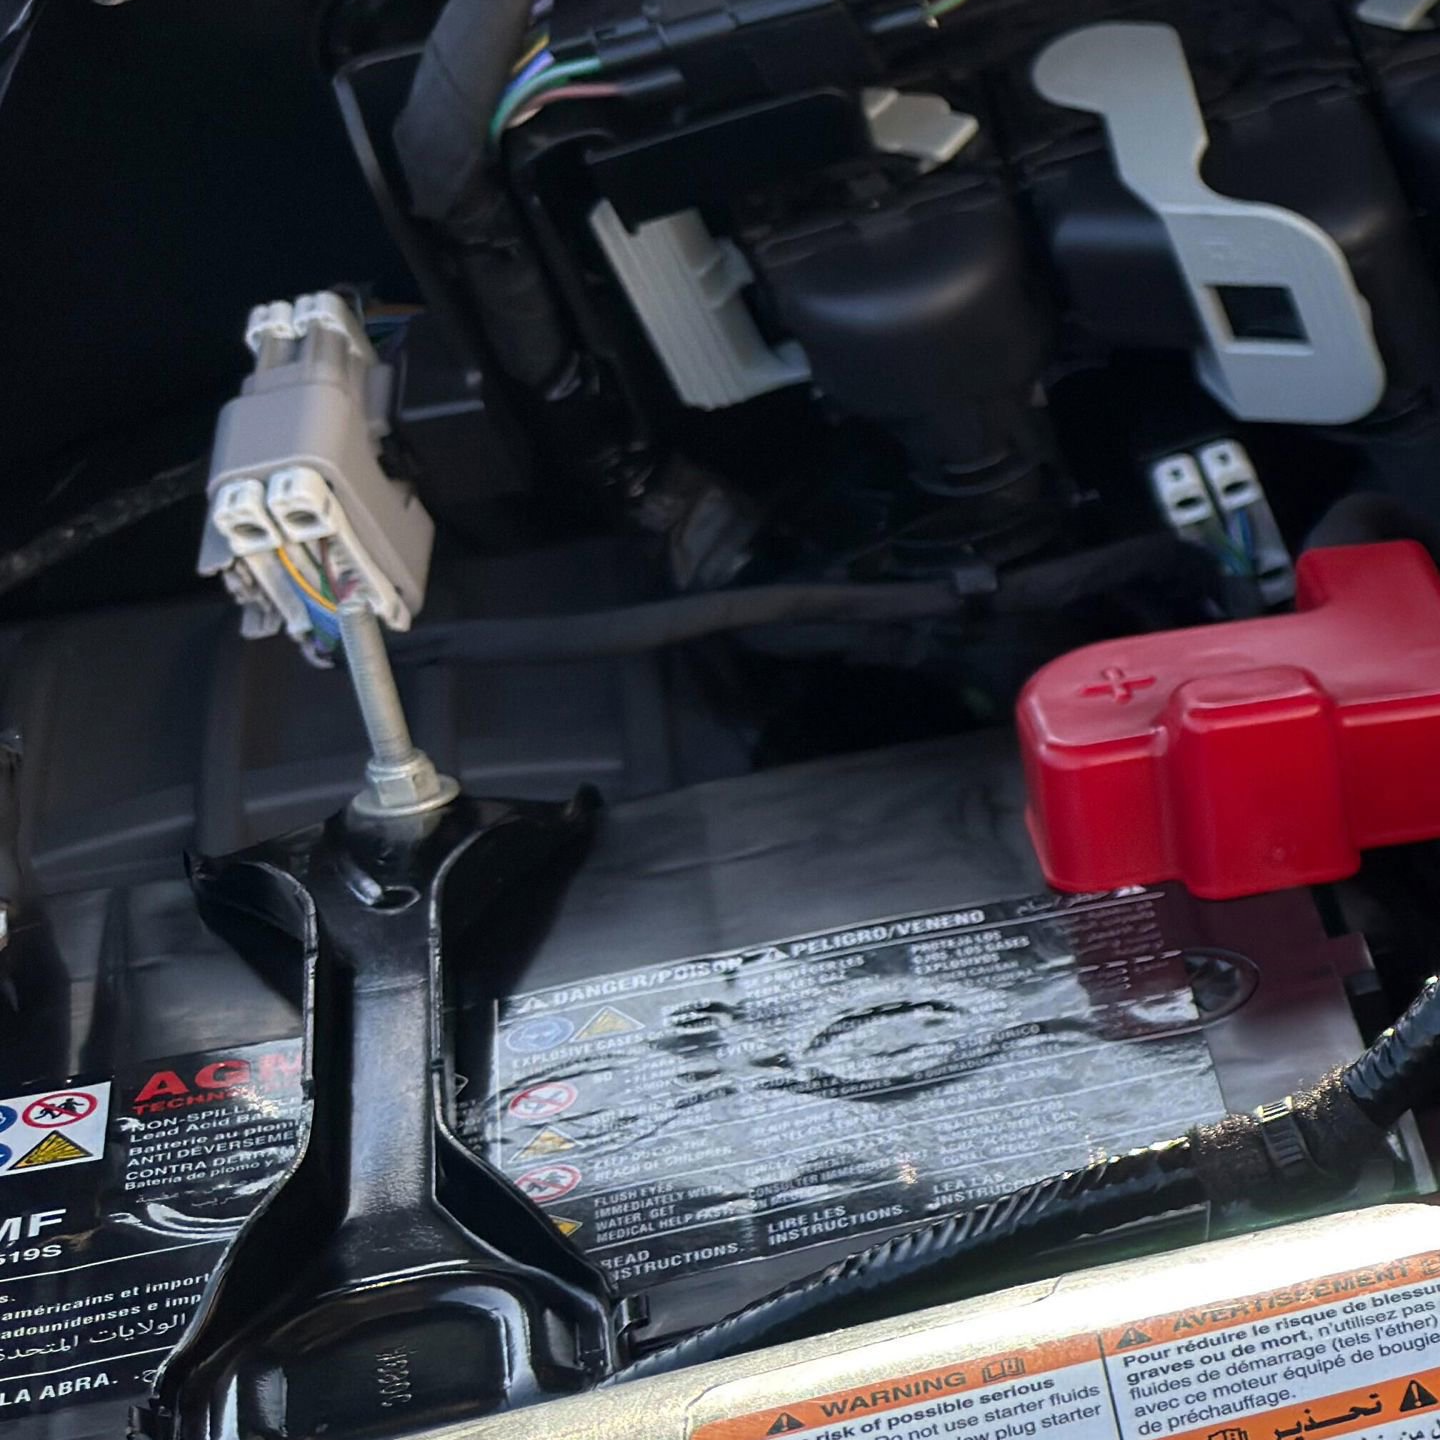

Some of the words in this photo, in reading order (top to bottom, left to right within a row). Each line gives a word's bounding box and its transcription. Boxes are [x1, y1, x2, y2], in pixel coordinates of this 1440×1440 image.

[792, 909, 986, 956] PELIGRO/VENENO
[128, 1135, 209, 1157] Batterie
[213, 1131, 239, 1142] au
[129, 1126, 180, 1144] Lead
[185, 1117, 231, 1134] Acid
[125, 1160, 208, 1182] CONTRA
[126, 1150, 172, 1169] ANTI
[186, 1170, 207, 1181] de
[210, 1162, 261, 1178] plomo
[594, 1219, 655, 1245] MEDICAL
[657, 1210, 693, 1230] HELP
[649, 1203, 676, 1220] GET
[765, 1213, 810, 1234] LIRE
[811, 1204, 847, 1223] LES
[767, 1203, 911, 1247] INSTRUCTIONS.
[1, 1291, 115, 1322] américains
[120, 1285, 140, 1300] et
[1171, 1266, 1408, 1333] AVERTISSEMENT
[1122, 1347, 1171, 1368] Pour
[1175, 1329, 1247, 1355] réduire
[1250, 1324, 1271, 1337] le
[1274, 1308, 1337, 1331] risque
[1341, 1301, 1367, 1315] de
[1125, 1358, 1195, 1386] graves
[1198, 1350, 1226, 1365] ou
[1230, 1343, 1256, 1358] de
[1259, 1329, 1313, 1351] mort,
[1316, 1308, 1398, 1337] n'utilisez
[1400, 1300, 1436, 1319] pas
[1128, 1376, 1192, 1401] fluides
[1195, 1368, 1221, 1384] de
[1224, 1342, 1326, 1377] démarrage
[1331, 1331, 1372, 1353] (tels
[1374, 1313, 1438, 1340] l'éther)
[39, 1371, 119, 1402] ABRA.
[819, 1371, 966, 1418] WARNING
[1133, 1396, 1180, 1418] avec
[1183, 1390, 1207, 1405] ce
[1211, 1371, 1278, 1399] moteur
[1282, 1352, 1346, 1381] équipé
[1349, 1348, 1375, 1364] de
[859, 1417, 881, 1434] of
[886, 1397, 974, 1431] possible
[978, 1378, 1055, 1405] serious
[907, 1422, 939, 1440] not
[943, 1414, 979, 1433] use
[983, 1398, 1045, 1423] starter
[1048, 1384, 1101, 1406] fluids
[1040, 1403, 1101, 1429] starter
[1137, 1419, 1162, 1436] de
[1166, 1388, 1297, 1431] préchauffage.
